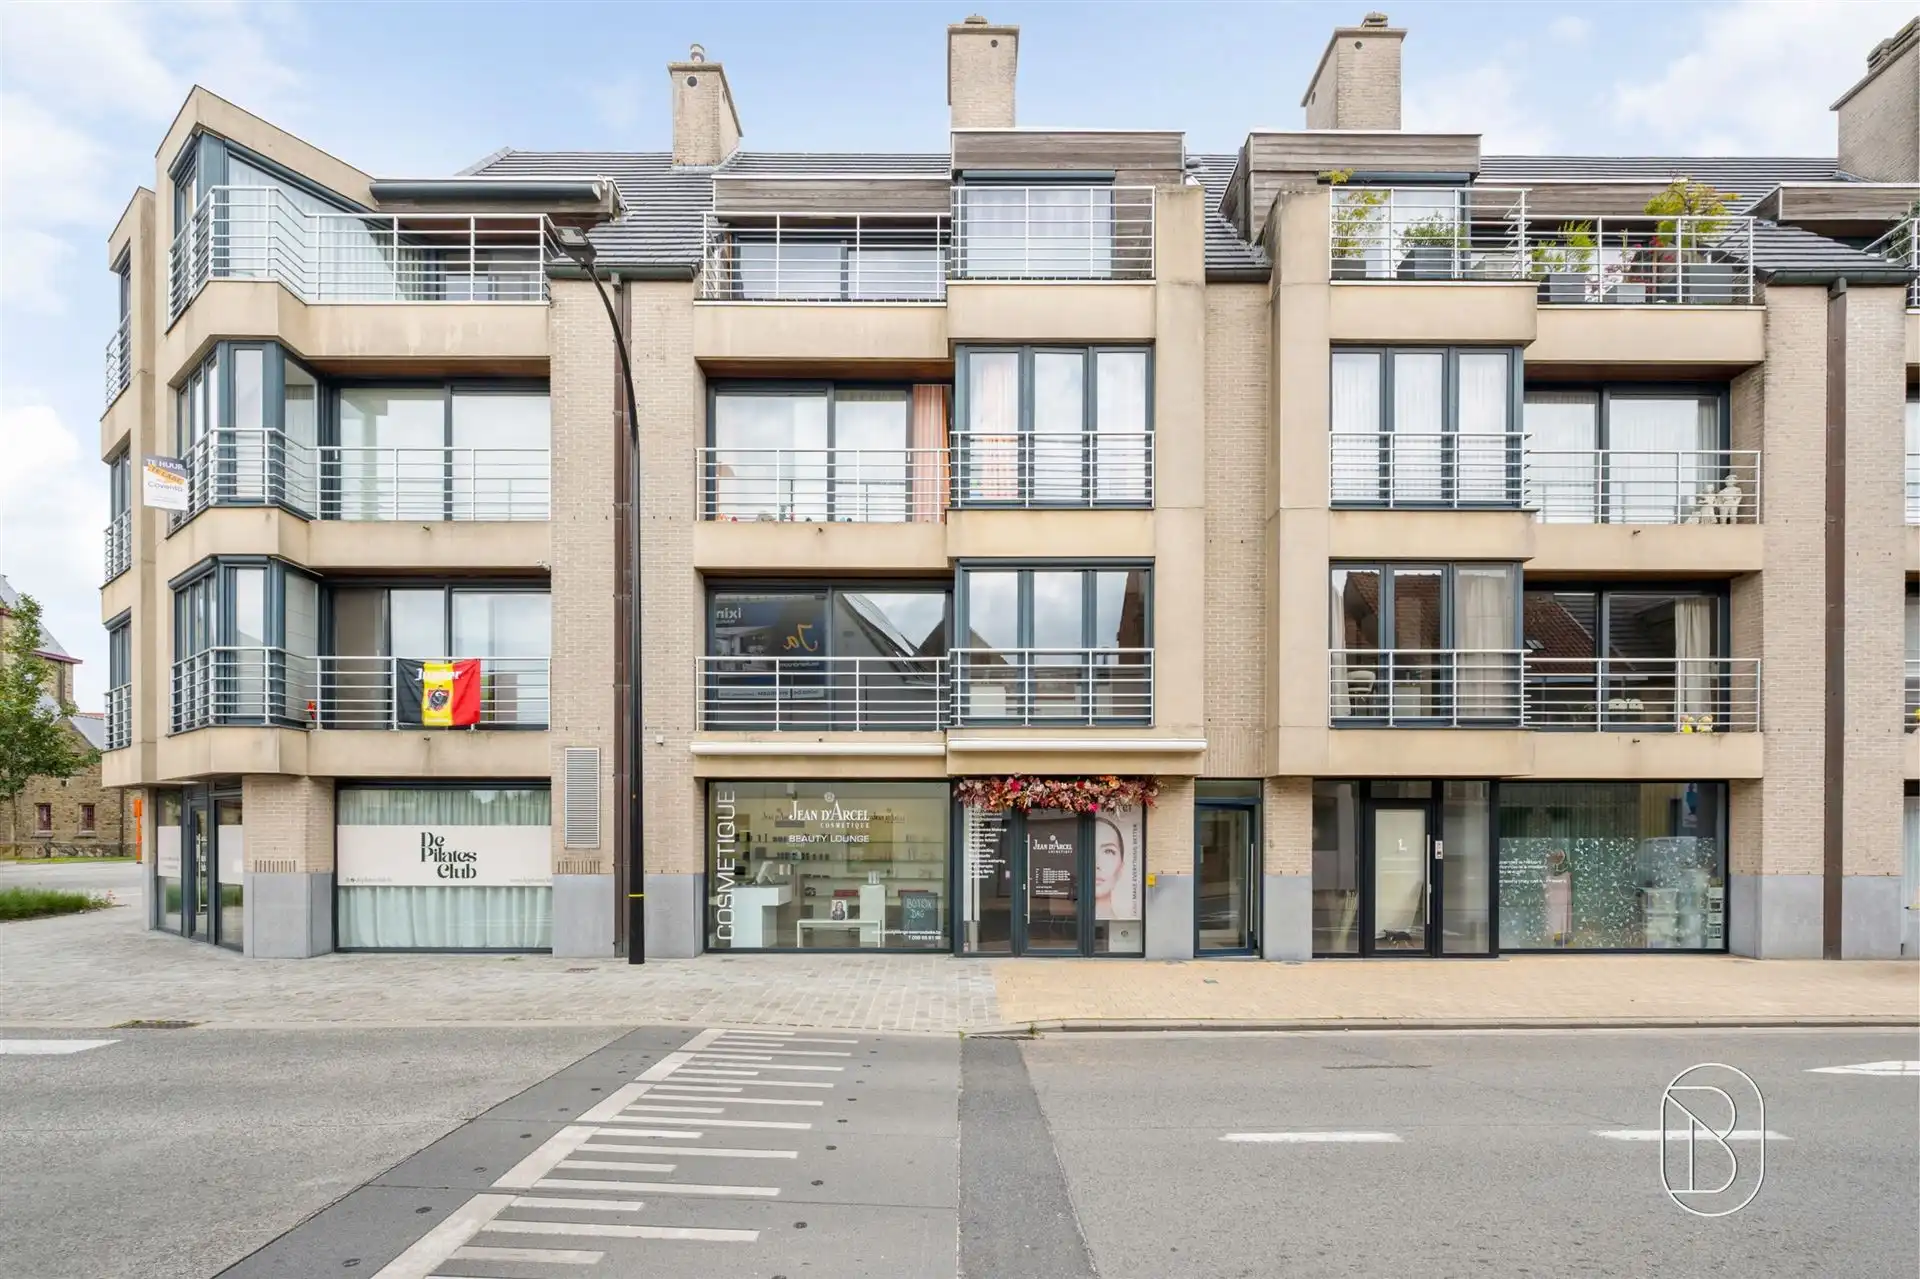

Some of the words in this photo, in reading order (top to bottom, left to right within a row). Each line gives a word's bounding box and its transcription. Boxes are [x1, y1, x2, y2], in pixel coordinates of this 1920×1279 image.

[159, 461, 184, 471] HUUR
[788, 800, 818, 821] JEAN
[820, 800, 870, 821] D'ARCEL
[421, 832, 445, 847] De
[788, 835, 826, 843] BEAUTY
[830, 835, 870, 843] LOUNGE
[421, 847, 477, 862] Pilates
[437, 863, 477, 879] Club
[716, 791, 736, 940] COSMETIQUE
[906, 898, 933, 910] BOTOX
